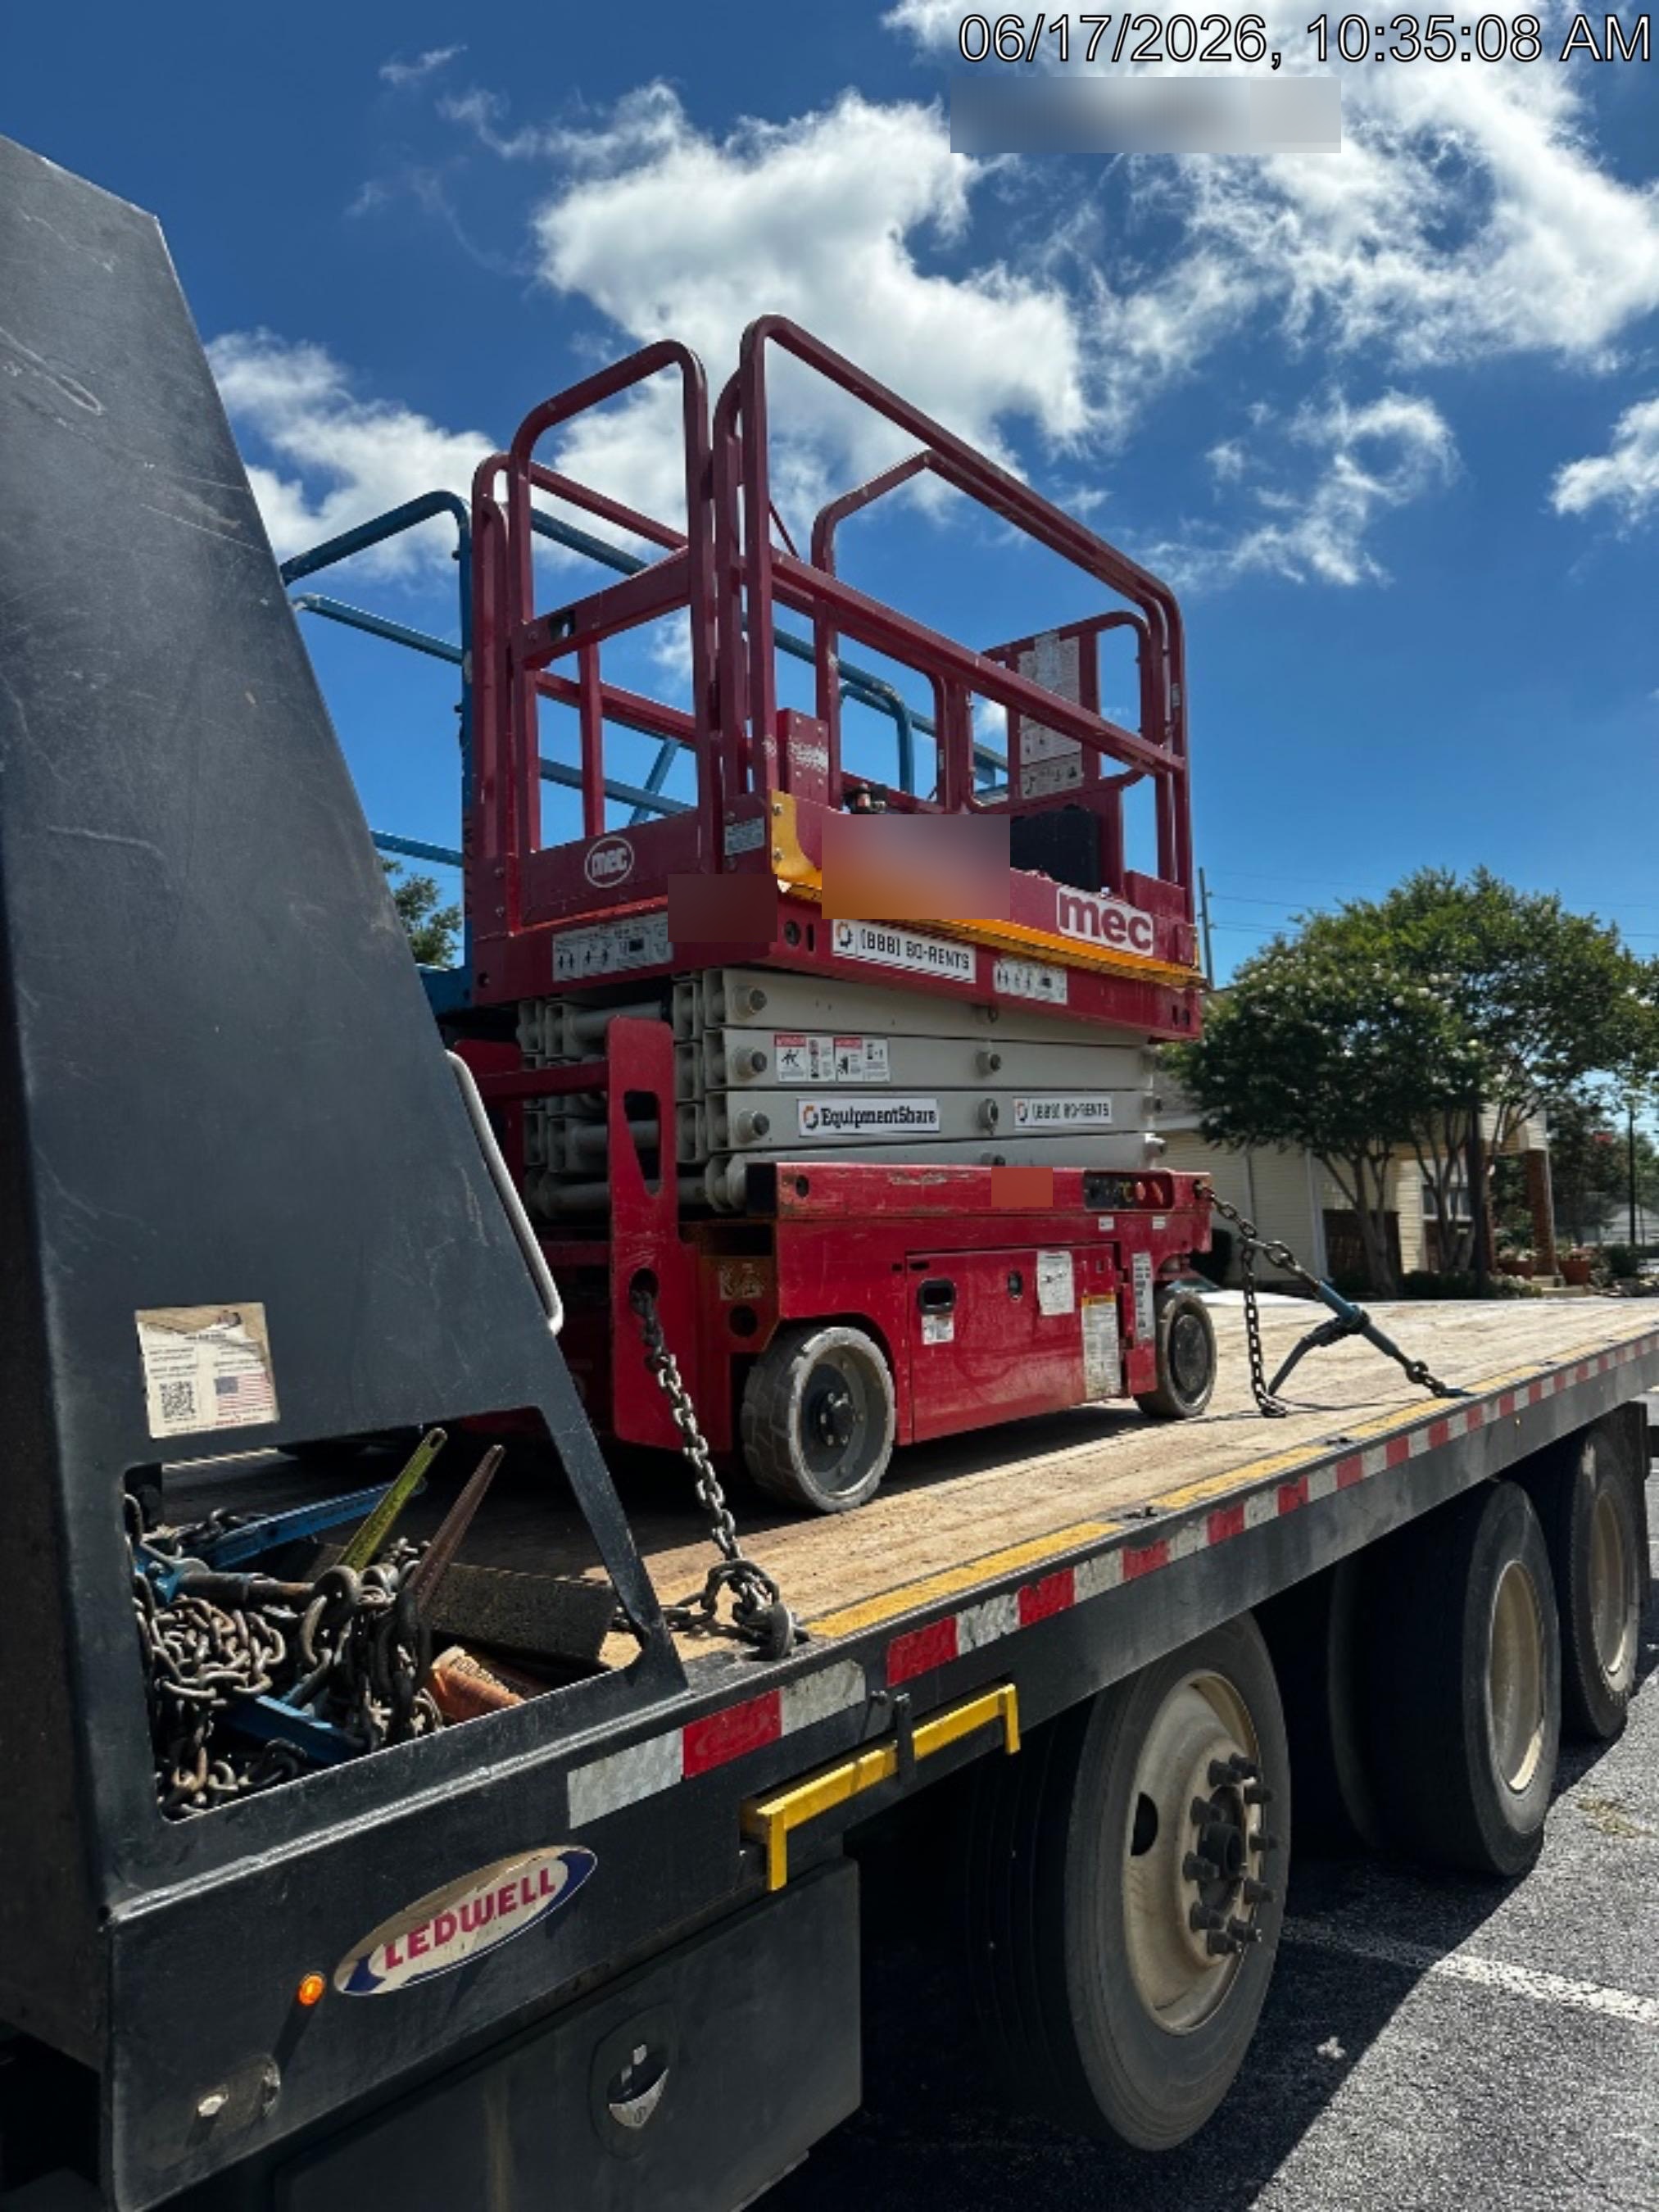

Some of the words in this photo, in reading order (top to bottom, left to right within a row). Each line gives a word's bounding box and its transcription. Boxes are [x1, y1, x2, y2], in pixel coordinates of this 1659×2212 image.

[1063, 895, 1151, 950] mec
[821, 1106, 936, 1129] EquipmentShare
[384, 1868, 555, 1970] LEDWELL
